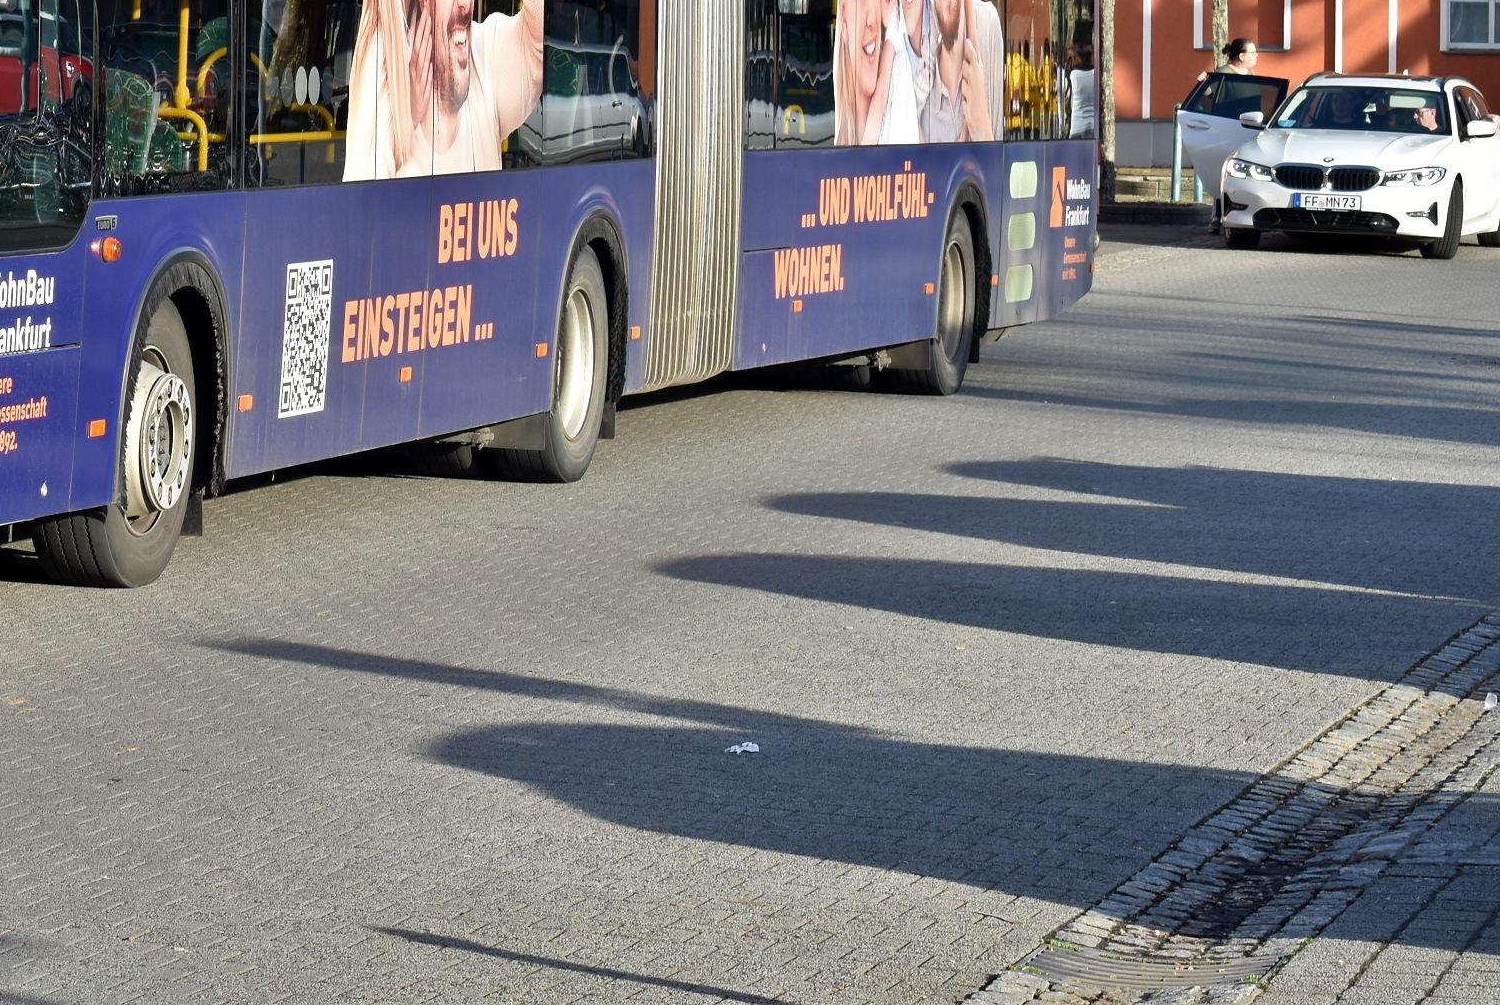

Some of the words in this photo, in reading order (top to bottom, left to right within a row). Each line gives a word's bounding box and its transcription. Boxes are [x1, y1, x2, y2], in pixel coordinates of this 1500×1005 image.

[819, 177, 850, 227] UND
[853, 160, 935, 224] WOHLFÜHL-
[1064, 204, 1090, 227] Frankfurt
[1066, 178, 1091, 200] WohnBau
[438, 202, 474, 264] BEI
[477, 198, 519, 260] UNS
[774, 243, 845, 300] WOHNEN.
